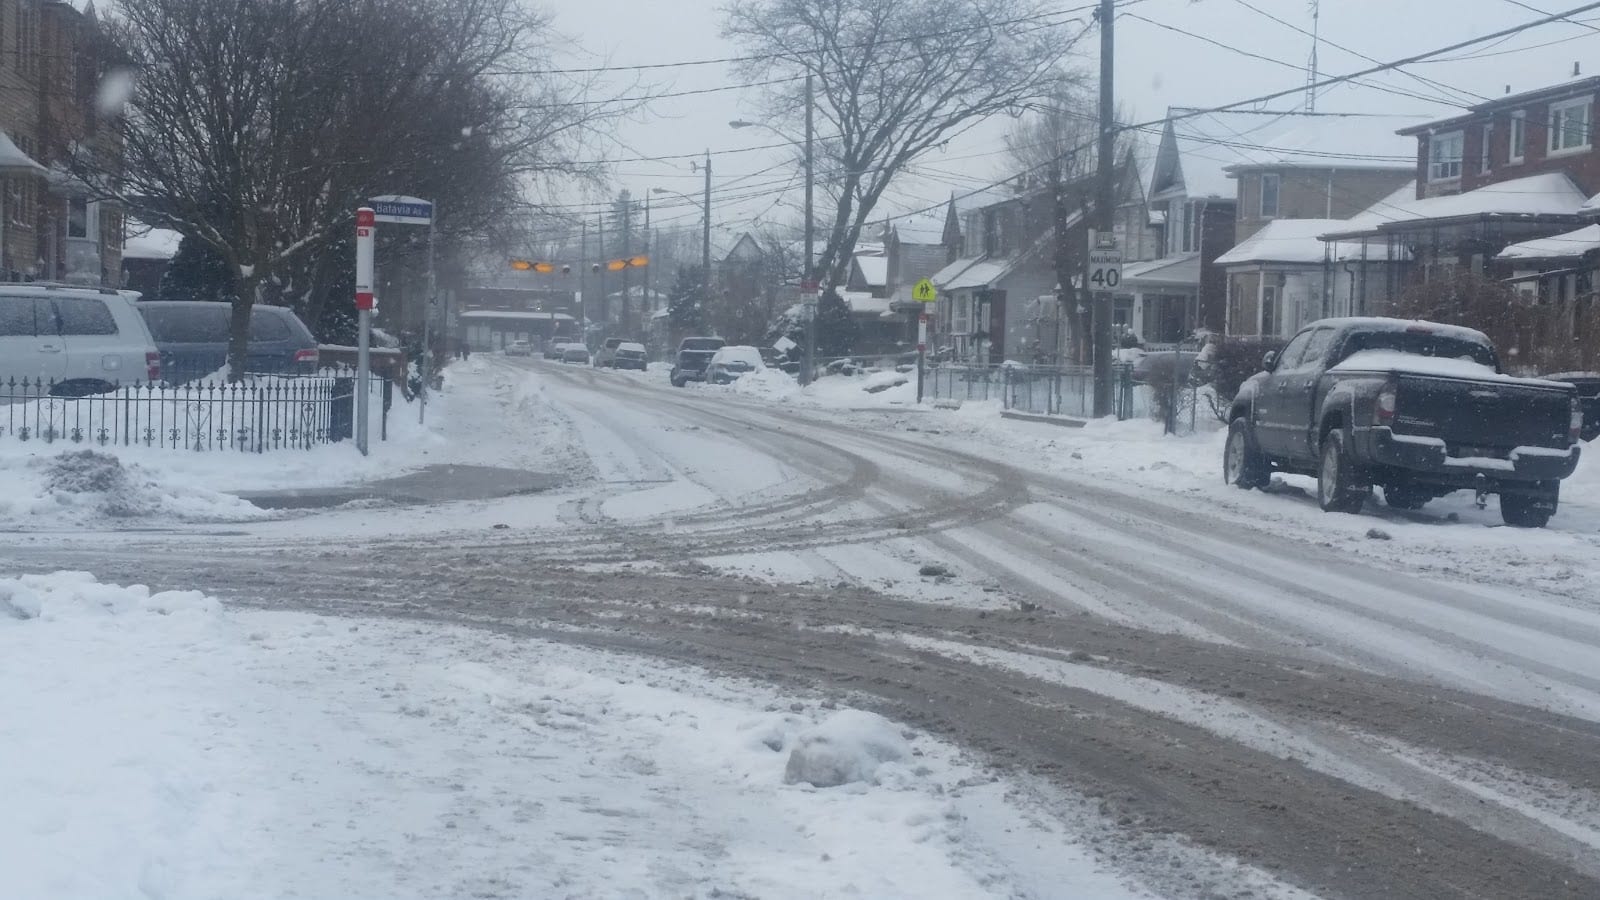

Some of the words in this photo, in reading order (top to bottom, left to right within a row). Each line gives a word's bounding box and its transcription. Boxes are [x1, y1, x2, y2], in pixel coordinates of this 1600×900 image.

[376, 203, 411, 216] Batavia
[1090, 255, 1121, 265] MAXIMUM
[1091, 268, 1120, 287] 40
